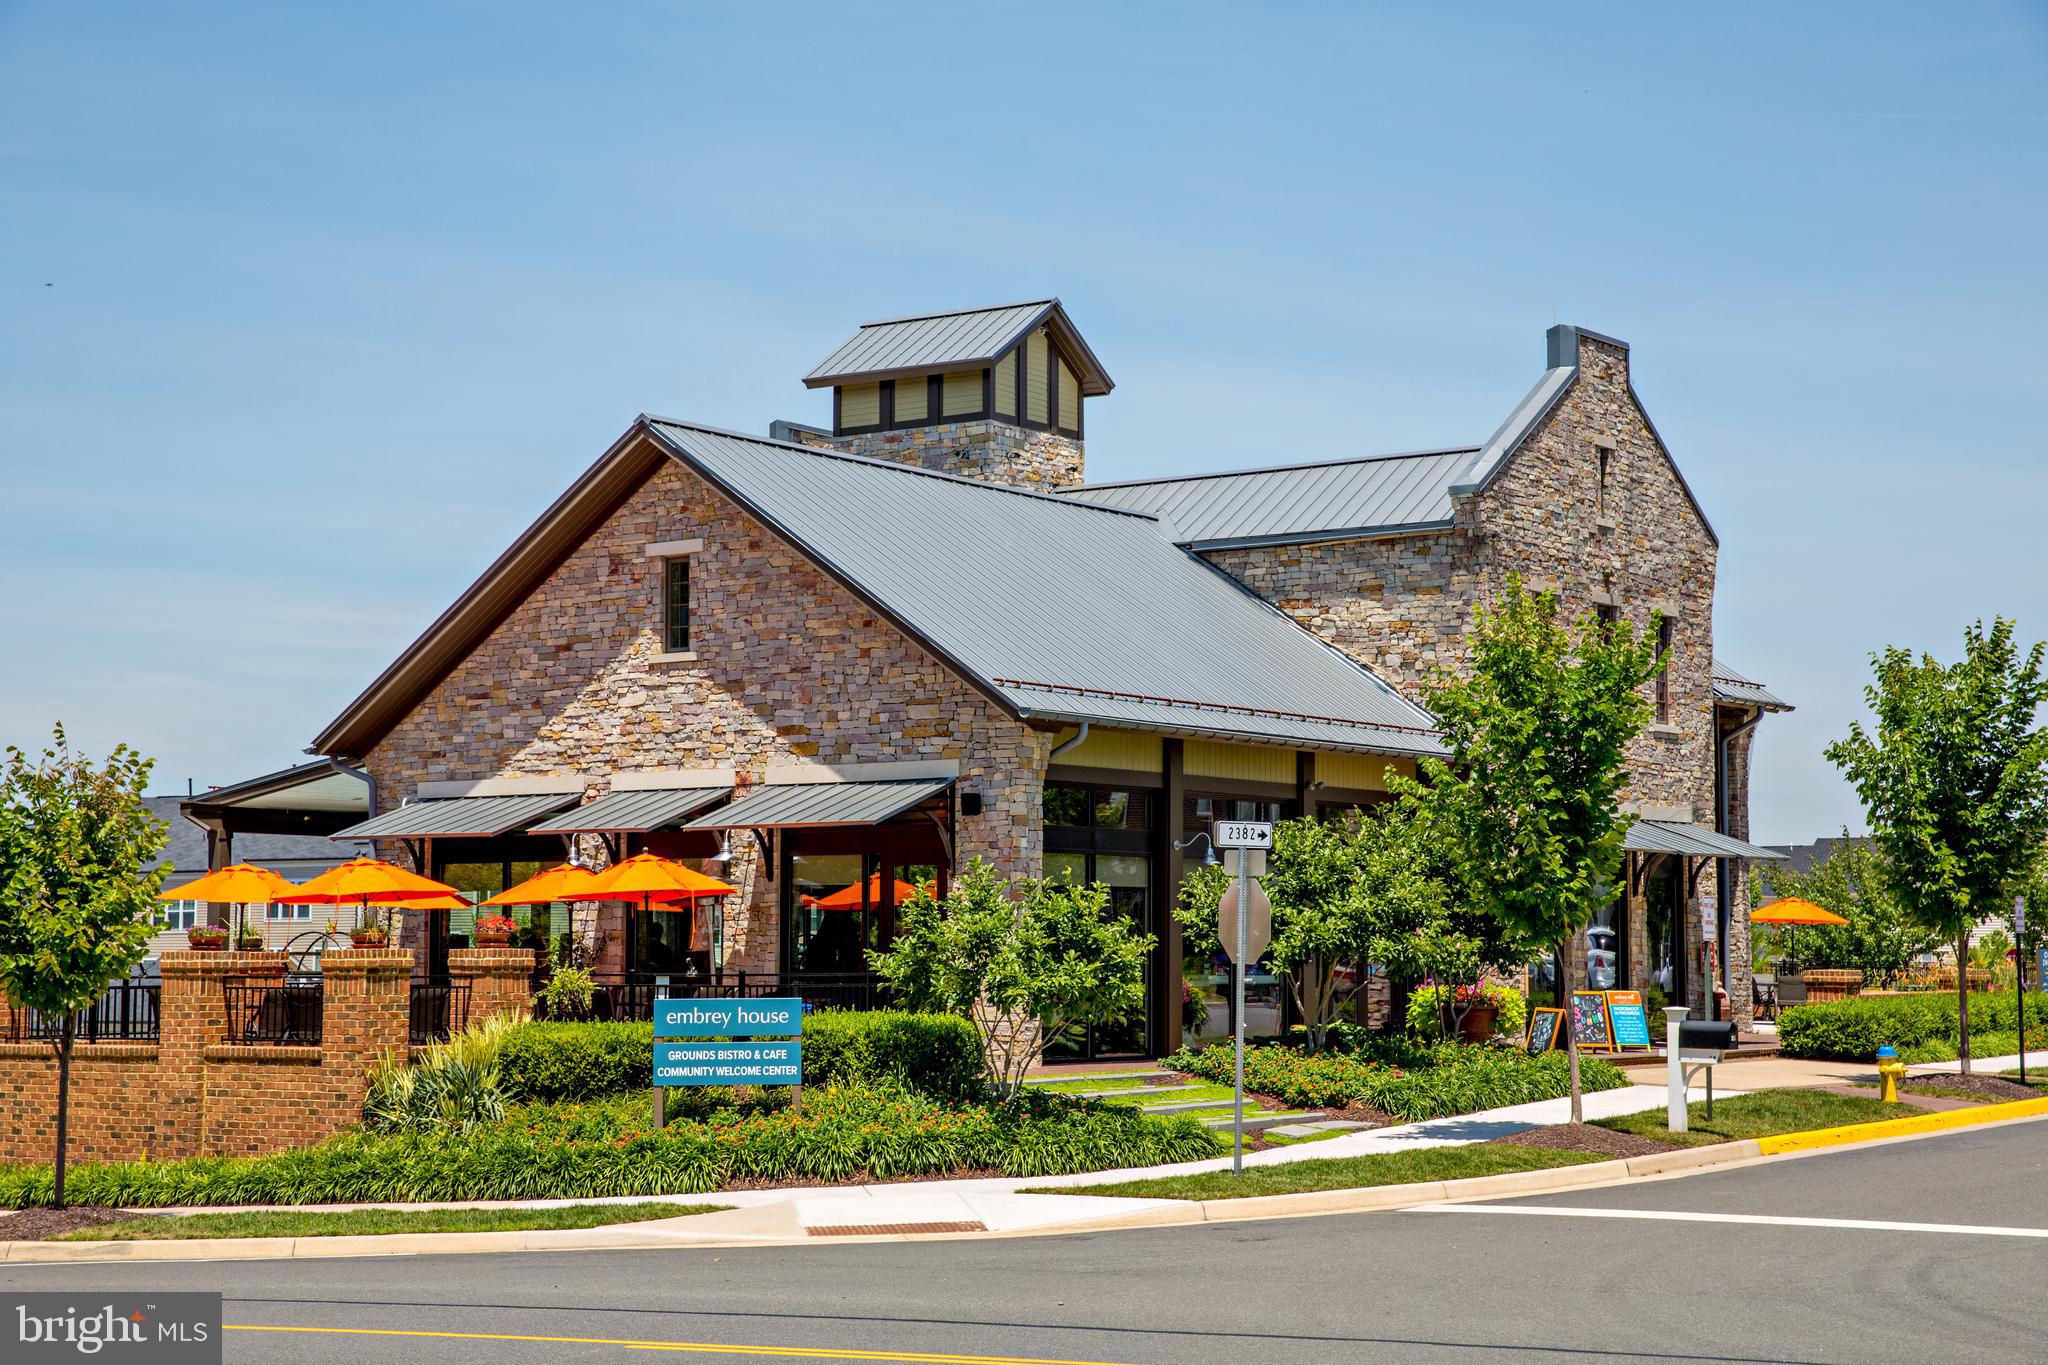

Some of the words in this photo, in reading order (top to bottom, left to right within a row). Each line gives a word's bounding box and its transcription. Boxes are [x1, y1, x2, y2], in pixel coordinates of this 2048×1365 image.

[1229, 827, 1255, 840] 2382
[666, 1007, 731, 1029] embrey
[738, 1007, 789, 1023] house
[668, 1050, 715, 1060] GROUNDS
[717, 1050, 751, 1060] BISTRO
[754, 1050, 761, 1060] &
[763, 1050, 787, 1059] CAFE
[657, 1067, 715, 1077] COMMUNITY
[716, 1066, 761, 1076] WELCOME
[763, 1065, 797, 1075] CENTER
